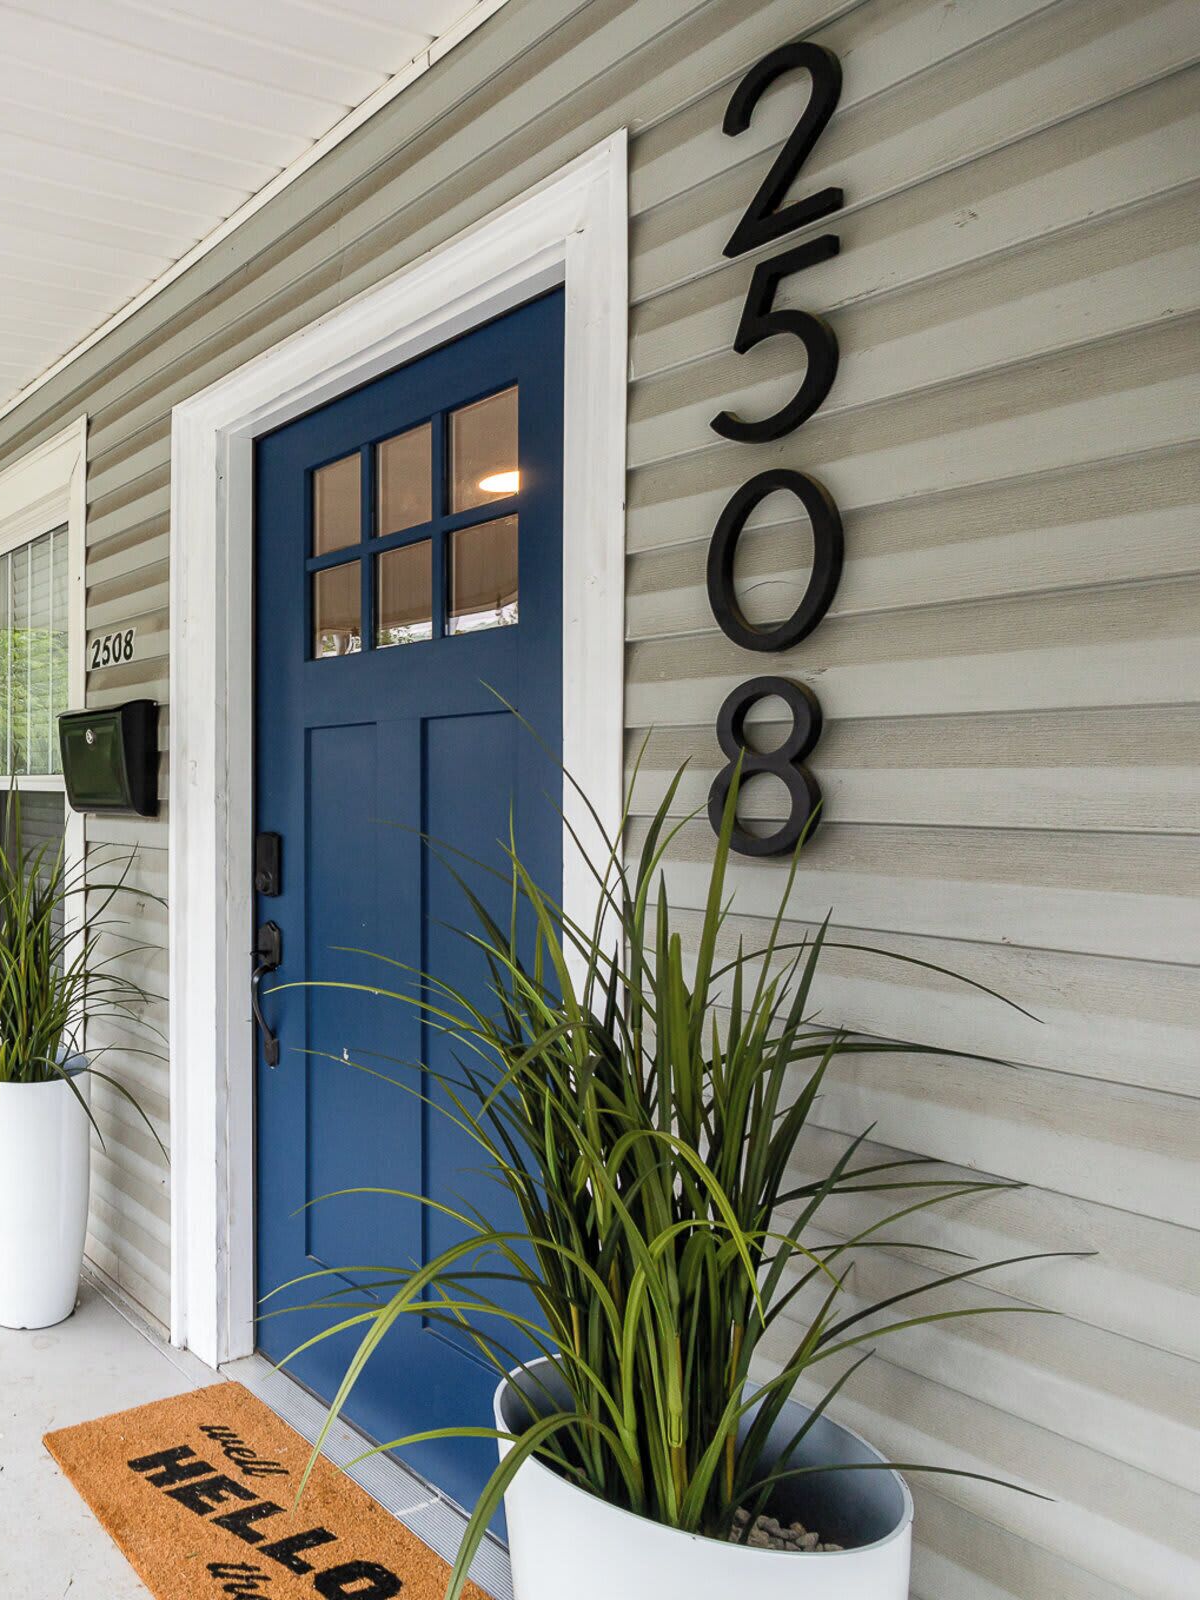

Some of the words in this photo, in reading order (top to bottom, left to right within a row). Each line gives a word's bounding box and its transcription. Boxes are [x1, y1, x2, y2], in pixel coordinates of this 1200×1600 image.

[707, 41, 844, 858] 2508
[91, 629, 134, 669] 2508
[199, 1425, 290, 1477] well
[127, 1444, 403, 1600] HELLO
